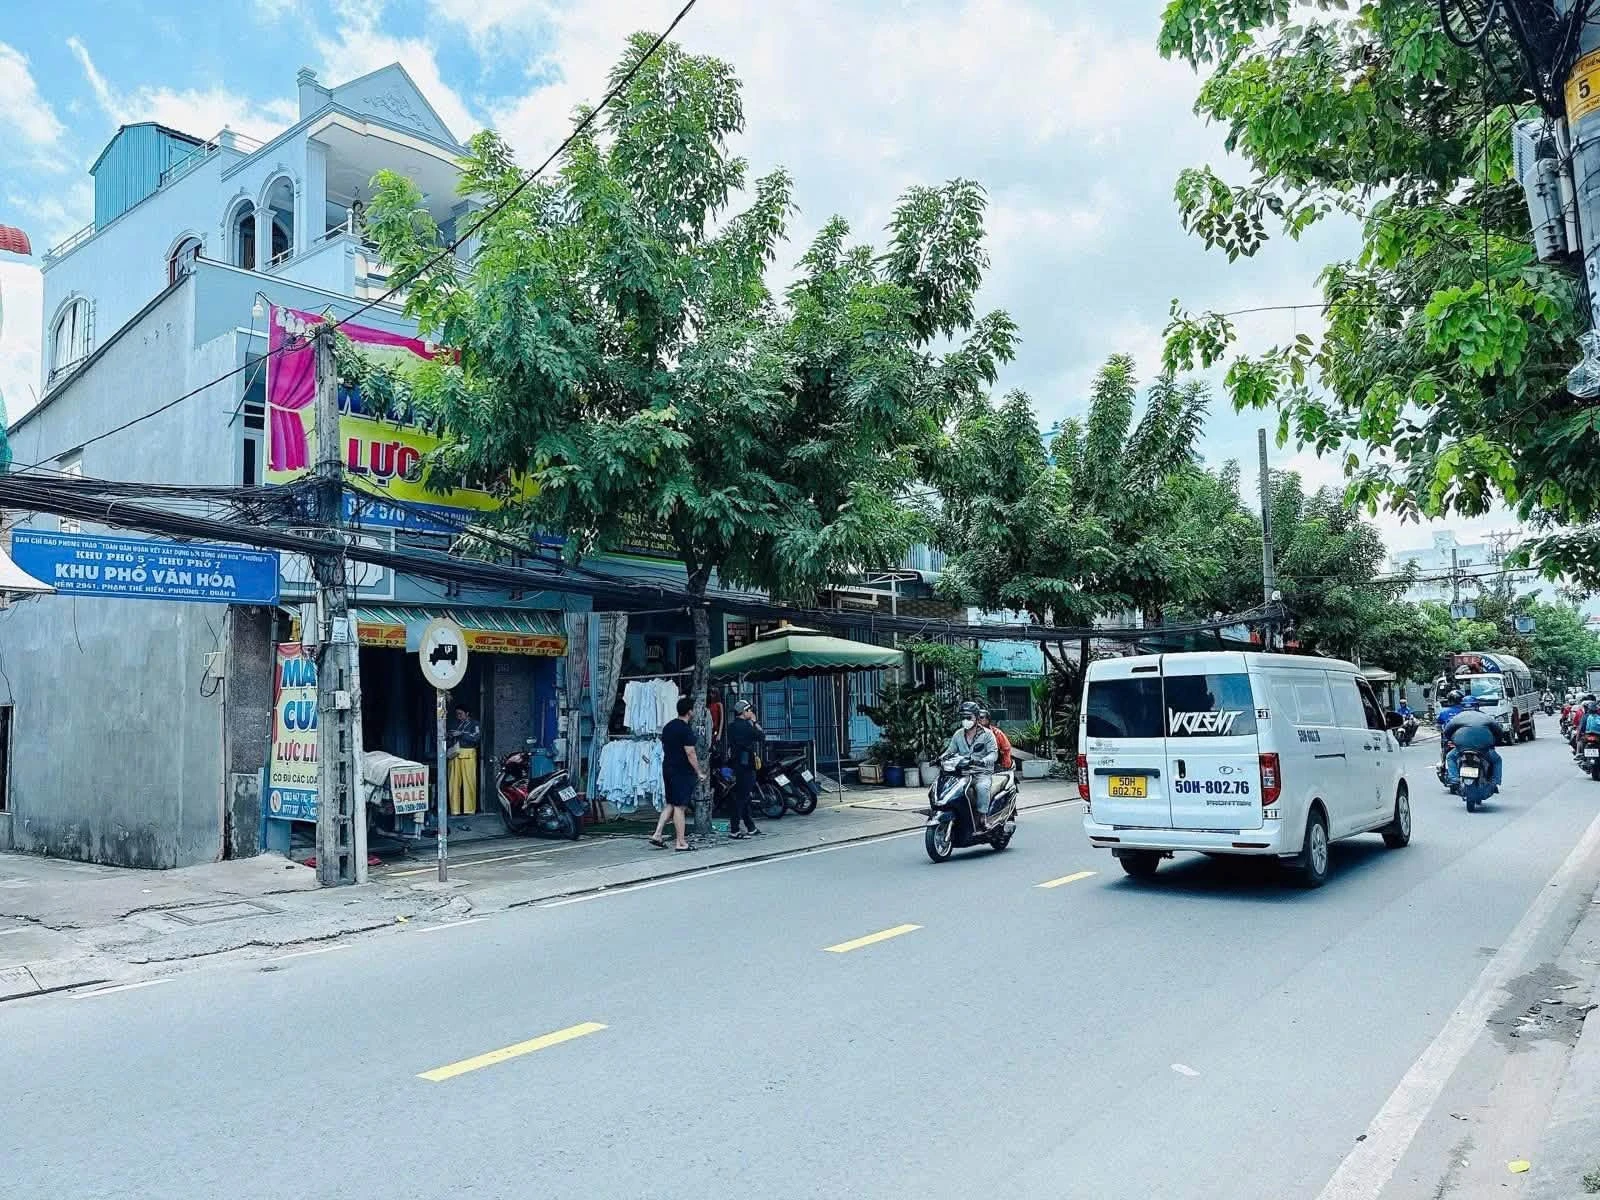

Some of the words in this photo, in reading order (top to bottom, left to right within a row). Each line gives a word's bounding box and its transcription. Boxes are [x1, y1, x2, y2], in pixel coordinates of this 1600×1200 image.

[1579, 78, 1590, 99] 5
[347, 438, 423, 487] LỰC
[76, 550, 103, 560] KHU
[106, 550, 134, 562] PHỐ
[137, 555, 145, 563] 5
[158, 557, 184, 567] KHU
[187, 558, 212, 569] PHỐ
[215, 561, 221, 569] 7
[55, 563, 99, 580] KHU
[104, 563, 148, 582] PHỐ
[151, 567, 192, 586] VĂN
[196, 571, 236, 589] HÓA
[1168, 706, 1245, 736] VIOLENT
[277, 739, 301, 765] LỰC
[1112, 786, 1143, 797] 802.76
[1119, 776, 1136, 787] 50H
[1175, 780, 1250, 795] 50H-802.76
[394, 789, 425, 802] SALE
